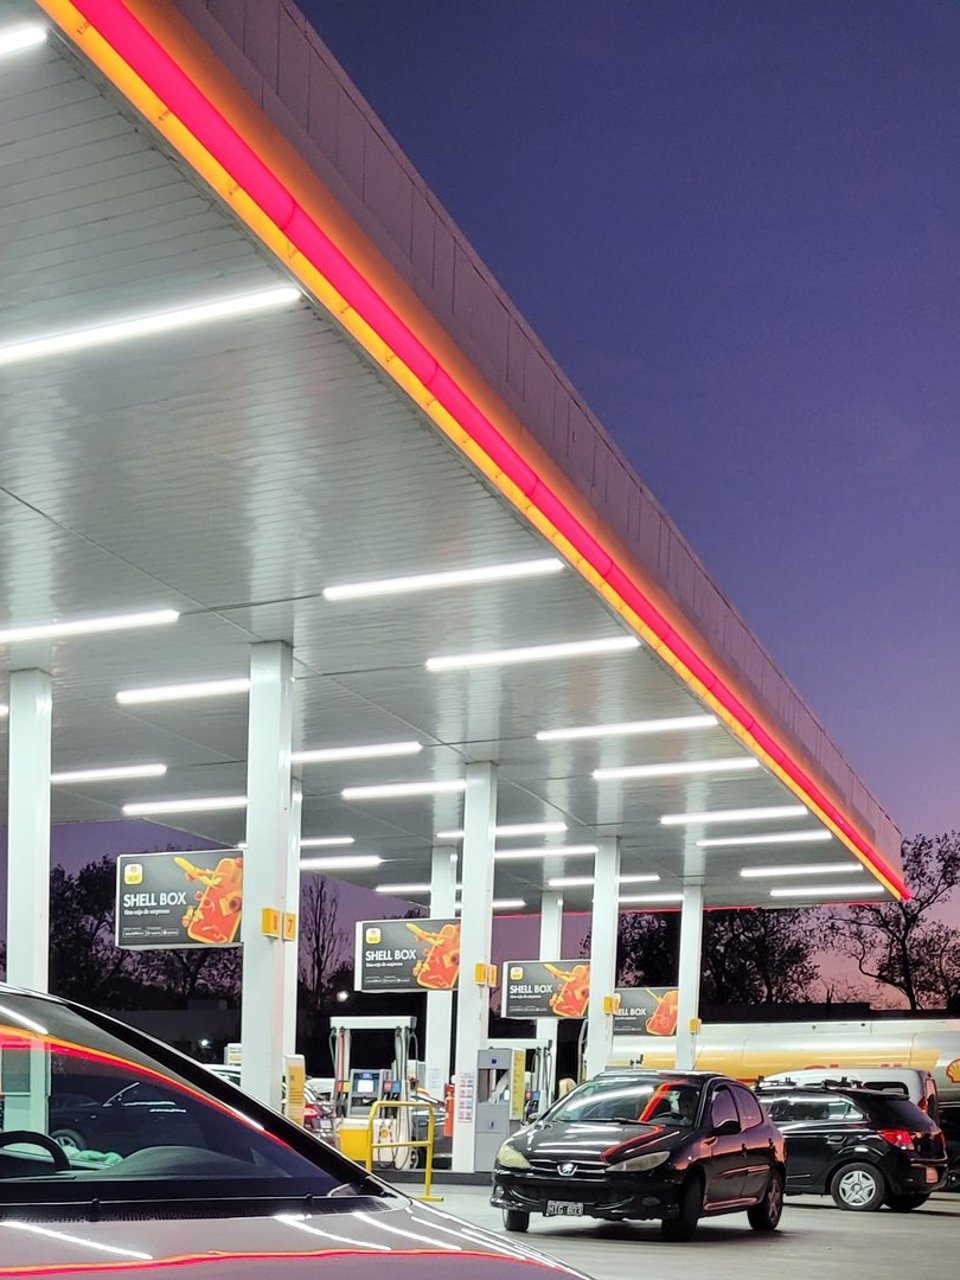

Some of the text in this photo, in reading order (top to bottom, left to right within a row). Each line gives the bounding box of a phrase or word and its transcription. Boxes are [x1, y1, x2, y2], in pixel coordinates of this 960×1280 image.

[123, 891, 187, 908] SHELL BOX
[365, 948, 417, 961] SHELL BOX
[509, 984, 553, 994] SHELL BOX
[630, 1008, 647, 1016] BOX
